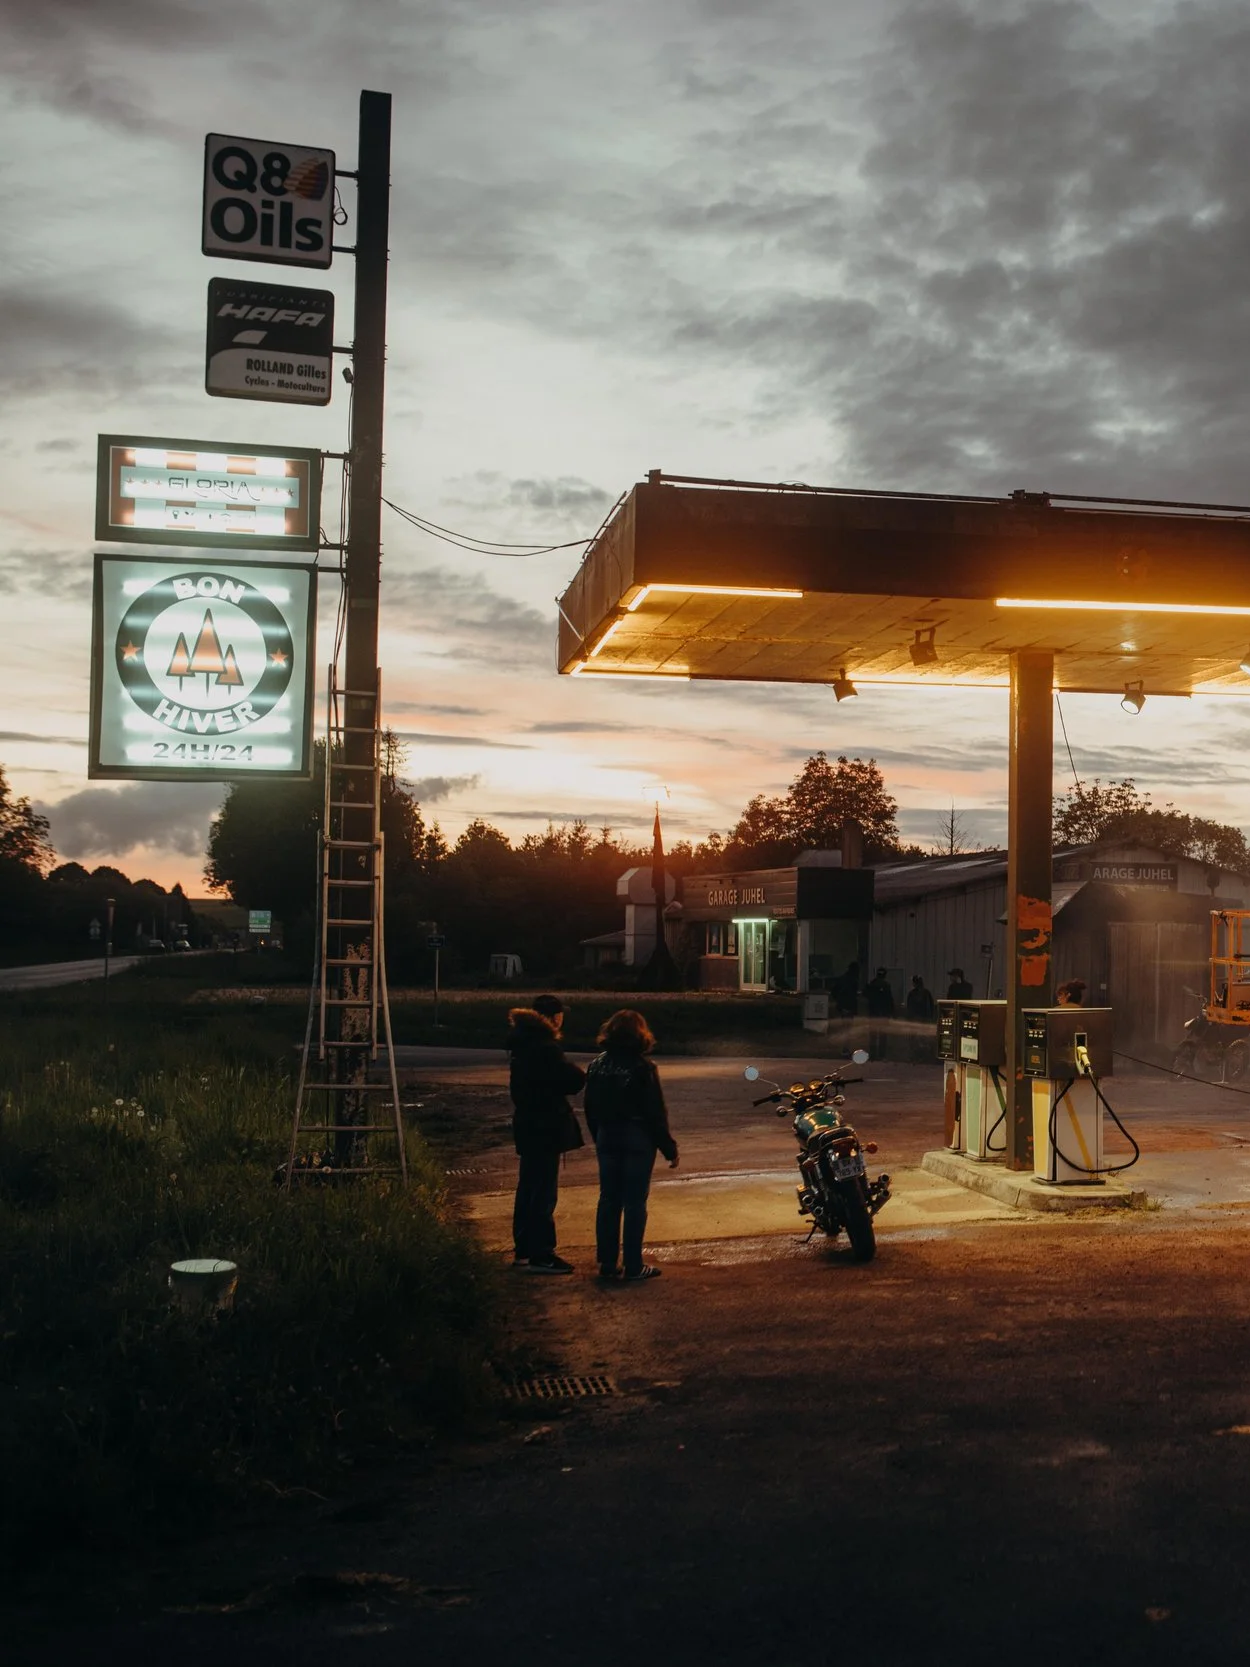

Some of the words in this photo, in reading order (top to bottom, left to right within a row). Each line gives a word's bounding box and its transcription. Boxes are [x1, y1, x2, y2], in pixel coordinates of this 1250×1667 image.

[212, 146, 291, 196] Q8
[210, 197, 323, 252] Oils
[216, 303, 326, 327] HAFA
[246, 358, 294, 375] ROLLAND
[297, 364, 327, 379] Gilles
[244, 375, 270, 387] Cycles
[172, 576, 245, 604] BON
[152, 699, 261, 733] HIVER
[152, 743, 253, 761] 24H/24
[1093, 867, 1135, 879] ARAGE
[1136, 868, 1174, 880] JUHEL
[708, 889, 738, 906] GARAGE
[741, 887, 766, 904] JUHEL
